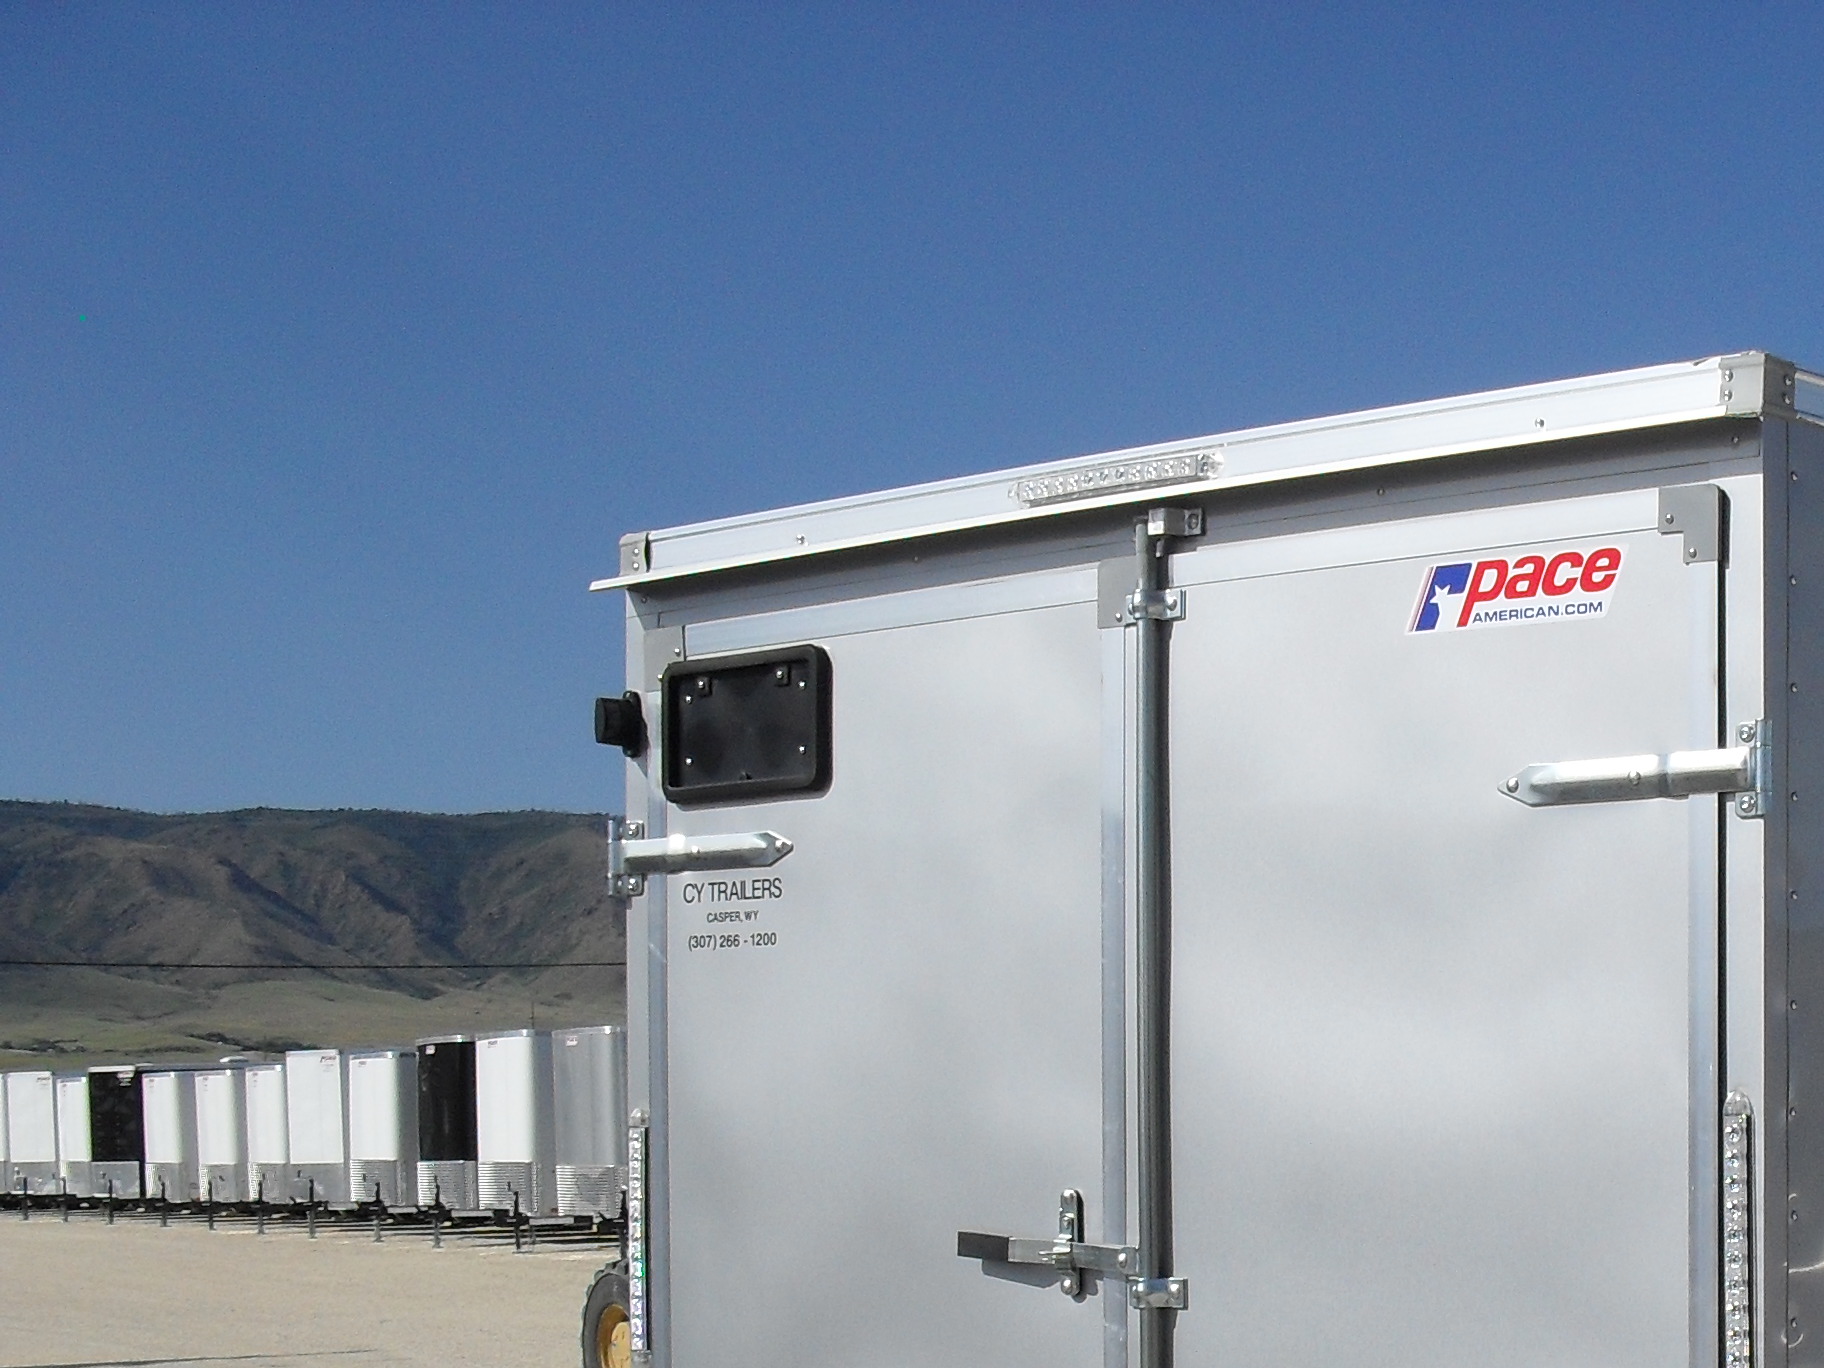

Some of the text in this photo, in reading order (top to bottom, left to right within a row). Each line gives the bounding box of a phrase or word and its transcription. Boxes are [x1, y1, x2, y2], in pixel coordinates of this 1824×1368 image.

[1456, 548, 1622, 628] pace
[1472, 601, 1603, 624] AMERICAN.COM
[683, 877, 783, 904] CY TRAILERS
[706, 910, 759, 923] CASPER, WY
[688, 934, 716, 951] (307)
[719, 934, 740, 948] 266
[750, 932, 777, 946] 1200
